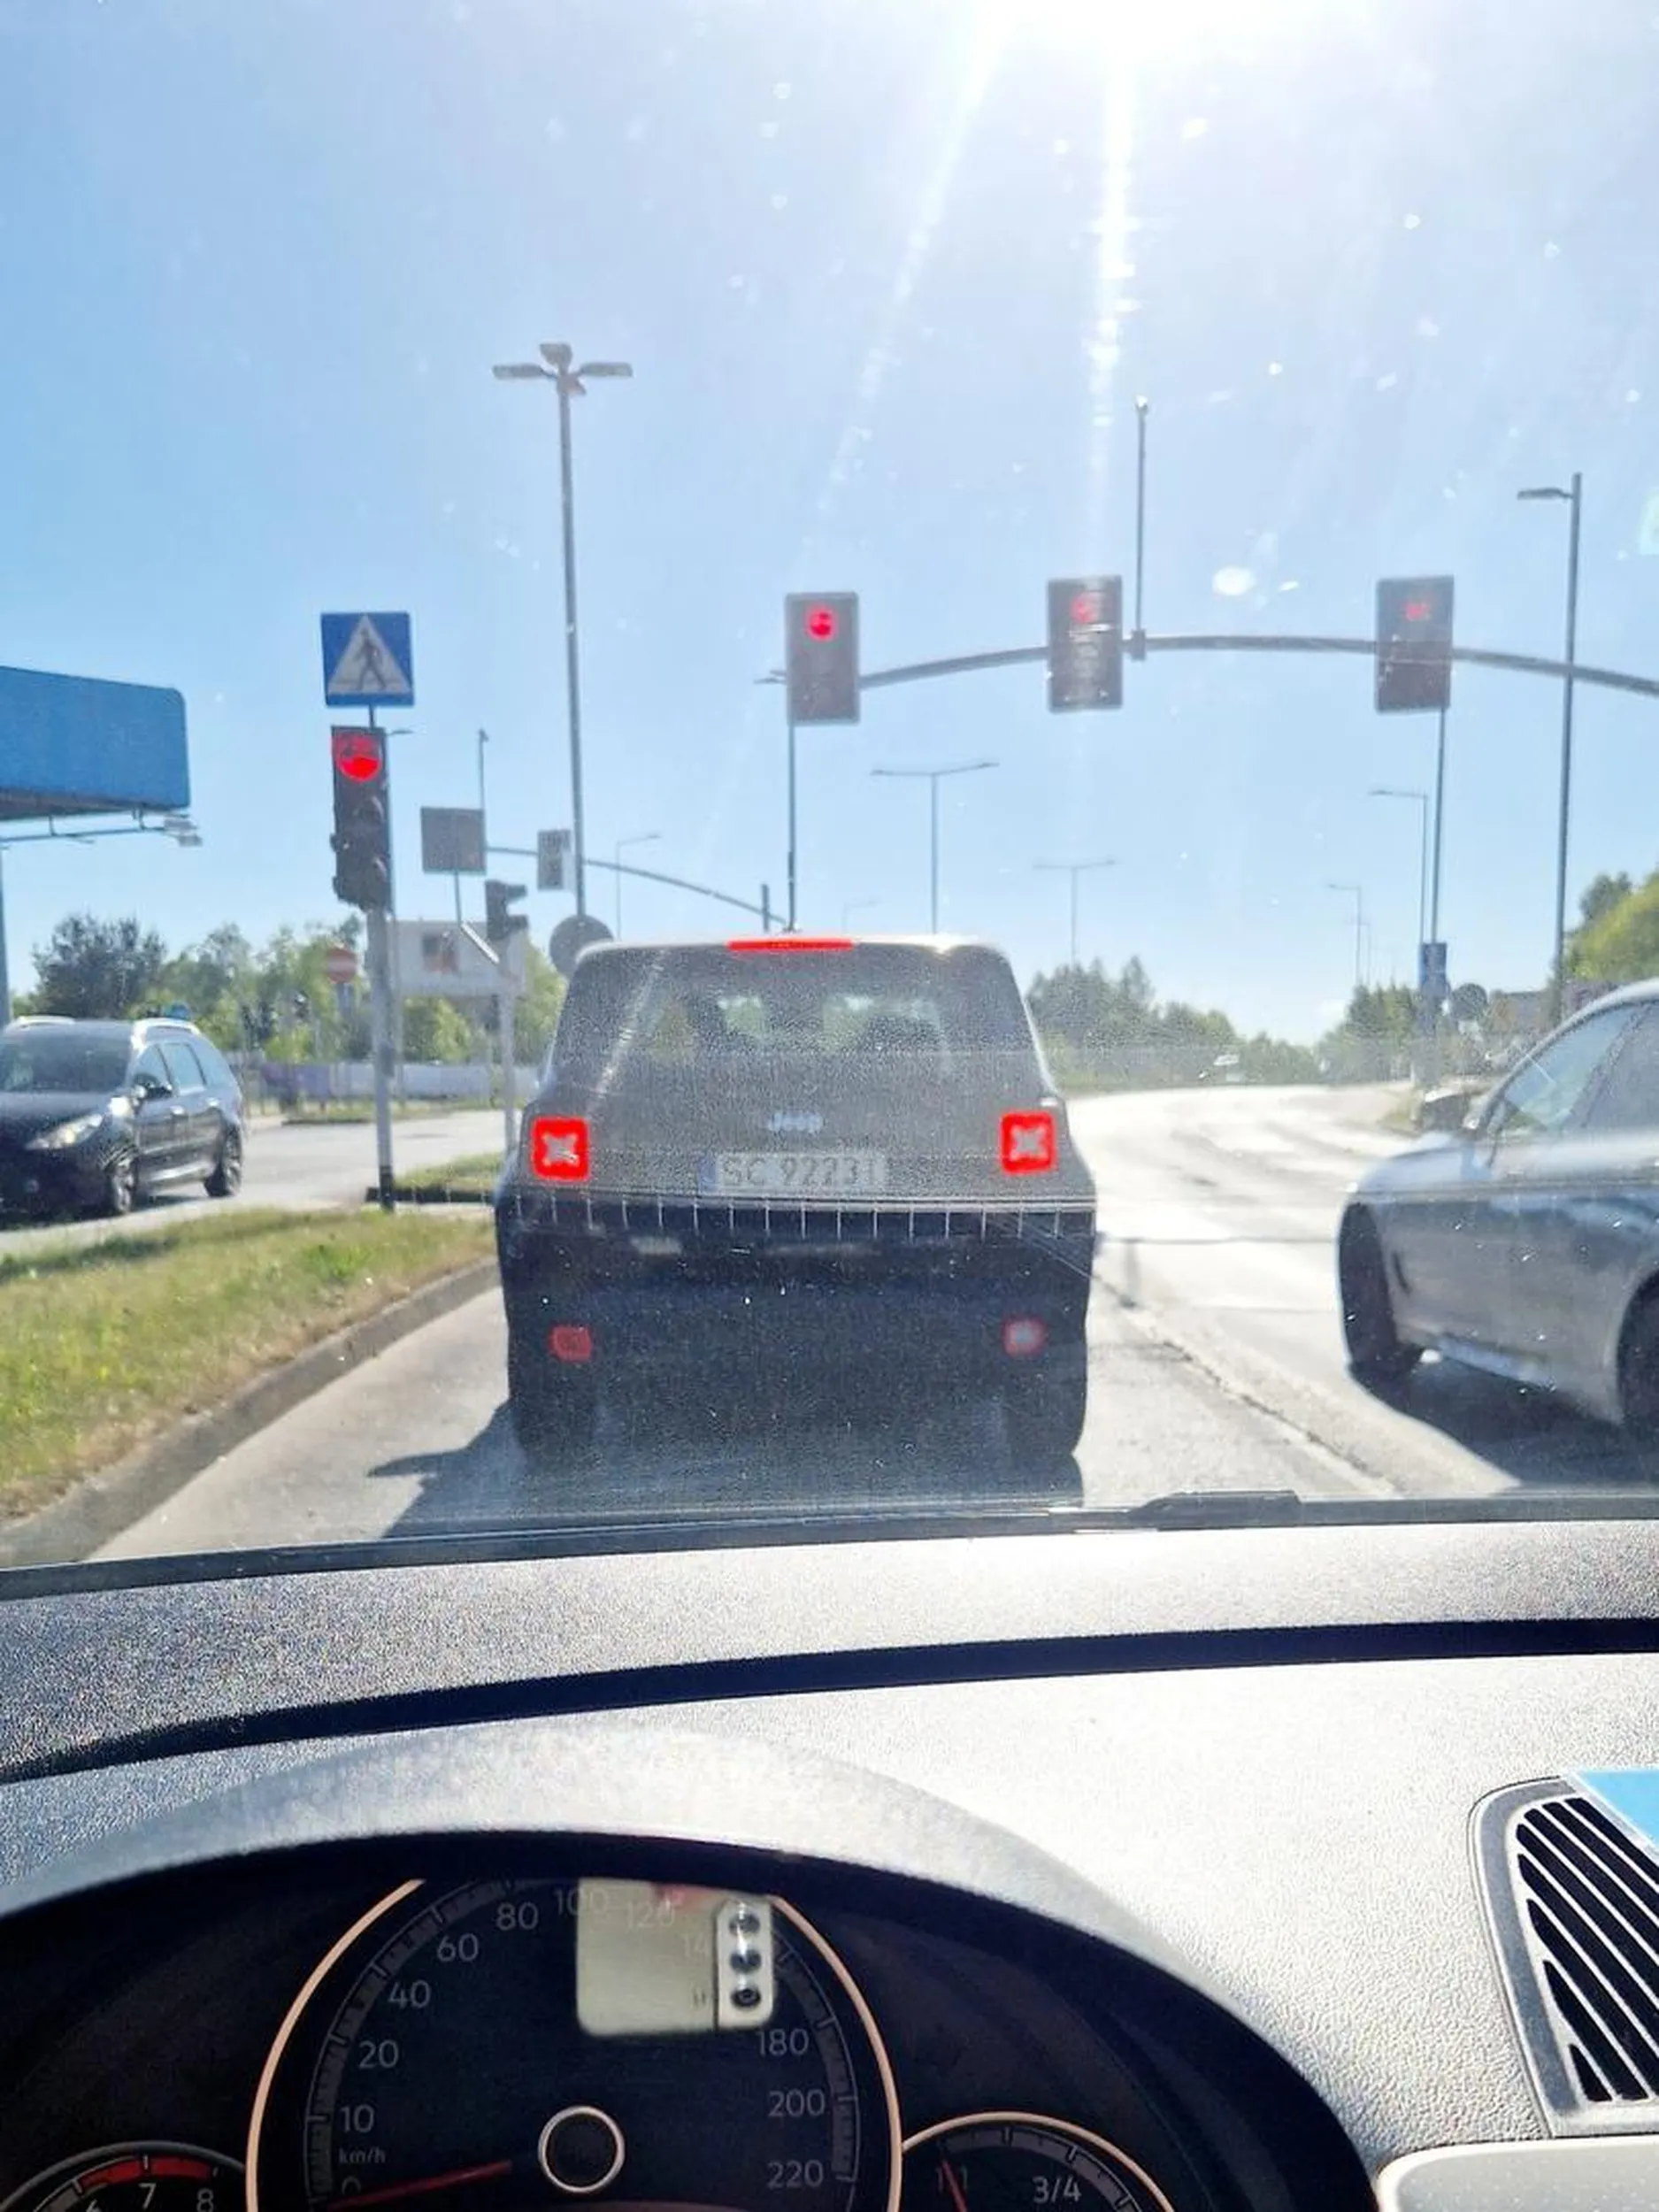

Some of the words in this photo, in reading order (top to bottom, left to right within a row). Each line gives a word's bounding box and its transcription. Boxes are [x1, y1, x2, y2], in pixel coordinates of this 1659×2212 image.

[495, 1902, 540, 1931] 80
[436, 1932, 480, 1962] 60
[387, 1979, 432, 2009] 40
[358, 2039, 399, 2069] 20
[756, 2028, 810, 2057] 180
[768, 2088, 826, 2118] 200
[340, 2104, 375, 2133] 10
[338, 2146, 387, 2164] km/h
[767, 2159, 825, 2190] 220
[138, 2182, 157, 2210] 7
[196, 2187, 215, 2212] 8
[1032, 2175, 1082, 2205] 3/4
